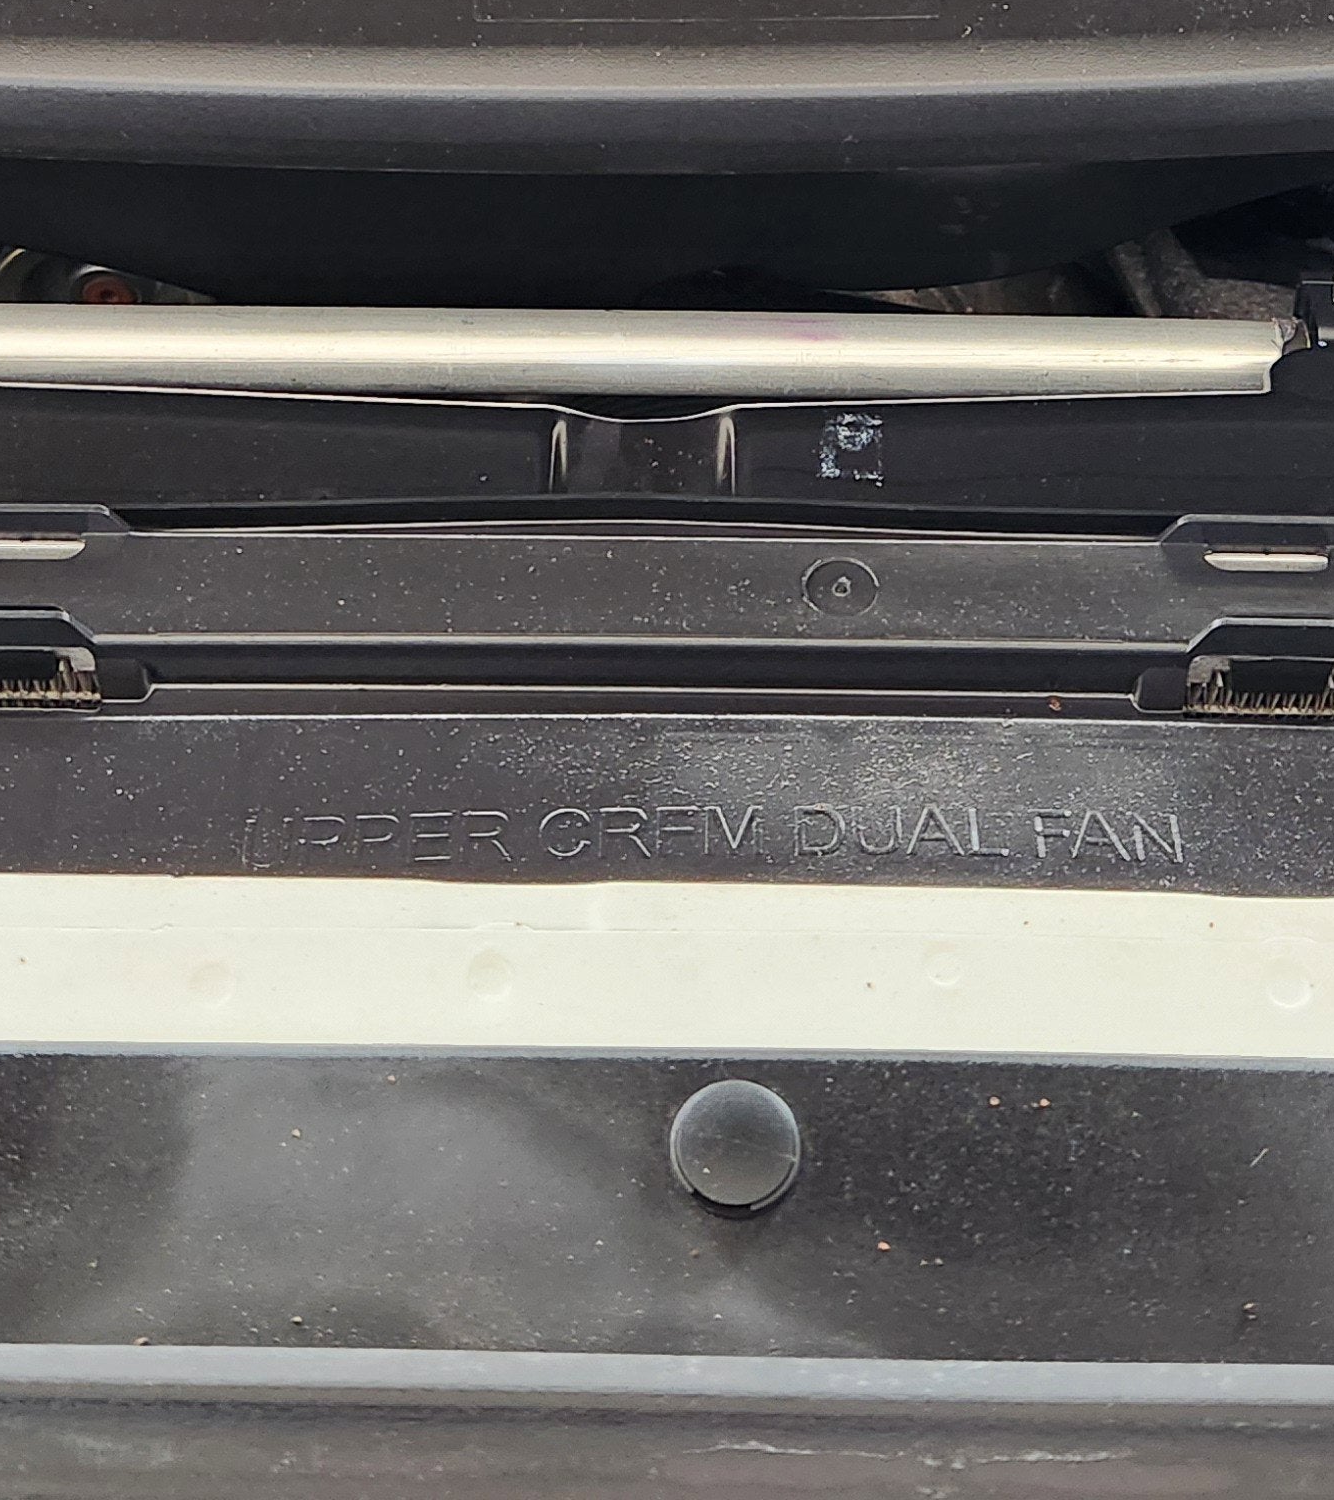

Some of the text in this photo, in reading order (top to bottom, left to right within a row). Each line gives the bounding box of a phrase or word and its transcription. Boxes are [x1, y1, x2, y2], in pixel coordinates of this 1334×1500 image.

[241, 803, 1186, 868] UPPER CRFM DUAL FAN
